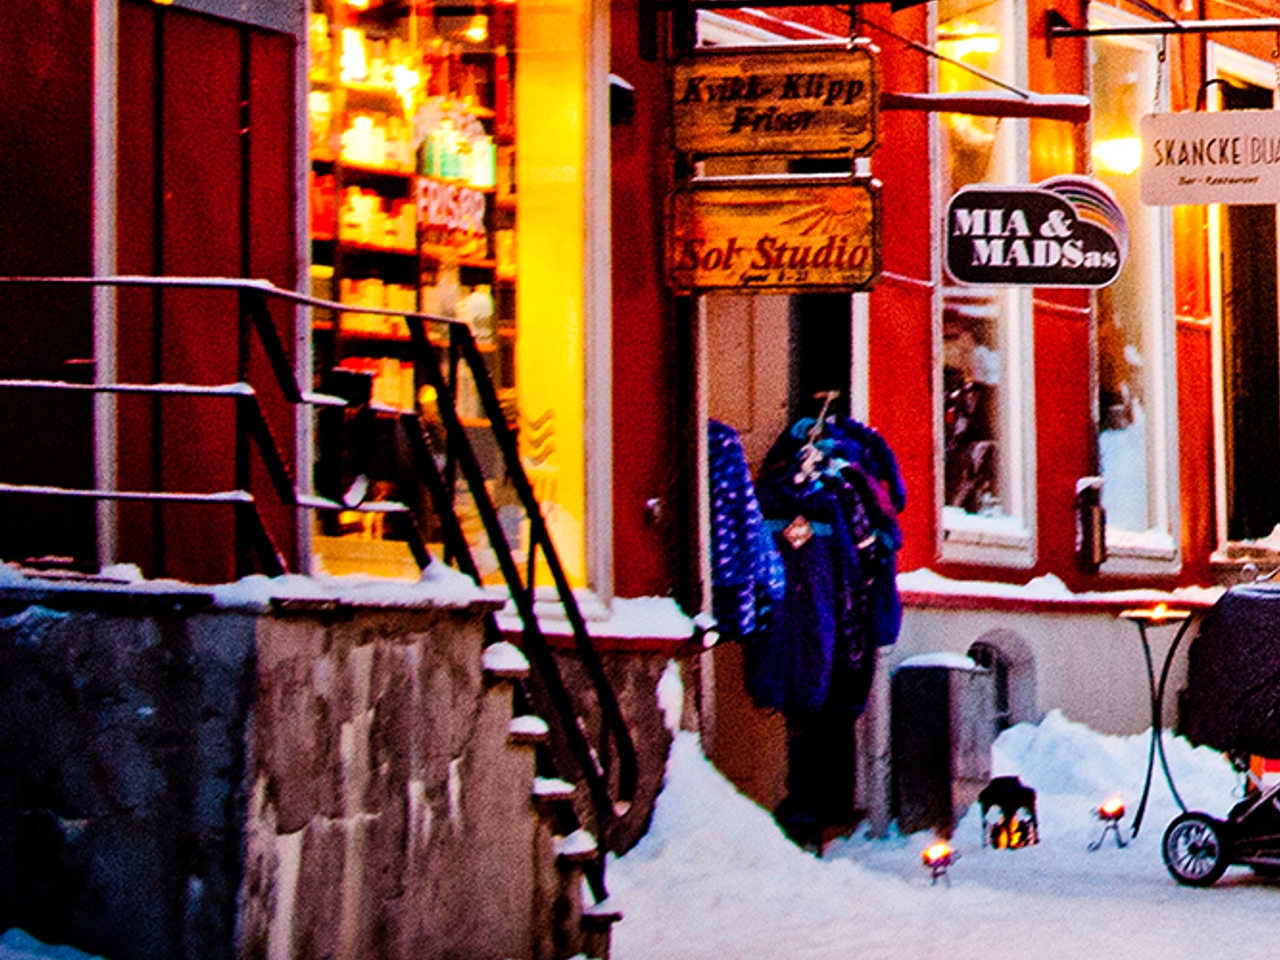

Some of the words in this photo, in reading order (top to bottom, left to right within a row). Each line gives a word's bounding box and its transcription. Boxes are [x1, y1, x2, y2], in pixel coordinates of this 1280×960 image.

[778, 72, 864, 106] Klipp
[1153, 137, 1240, 167] SKANCKE
[953, 208, 1031, 237] MIA
[1040, 209, 1074, 238] &
[751, 233, 869, 271] Studio
